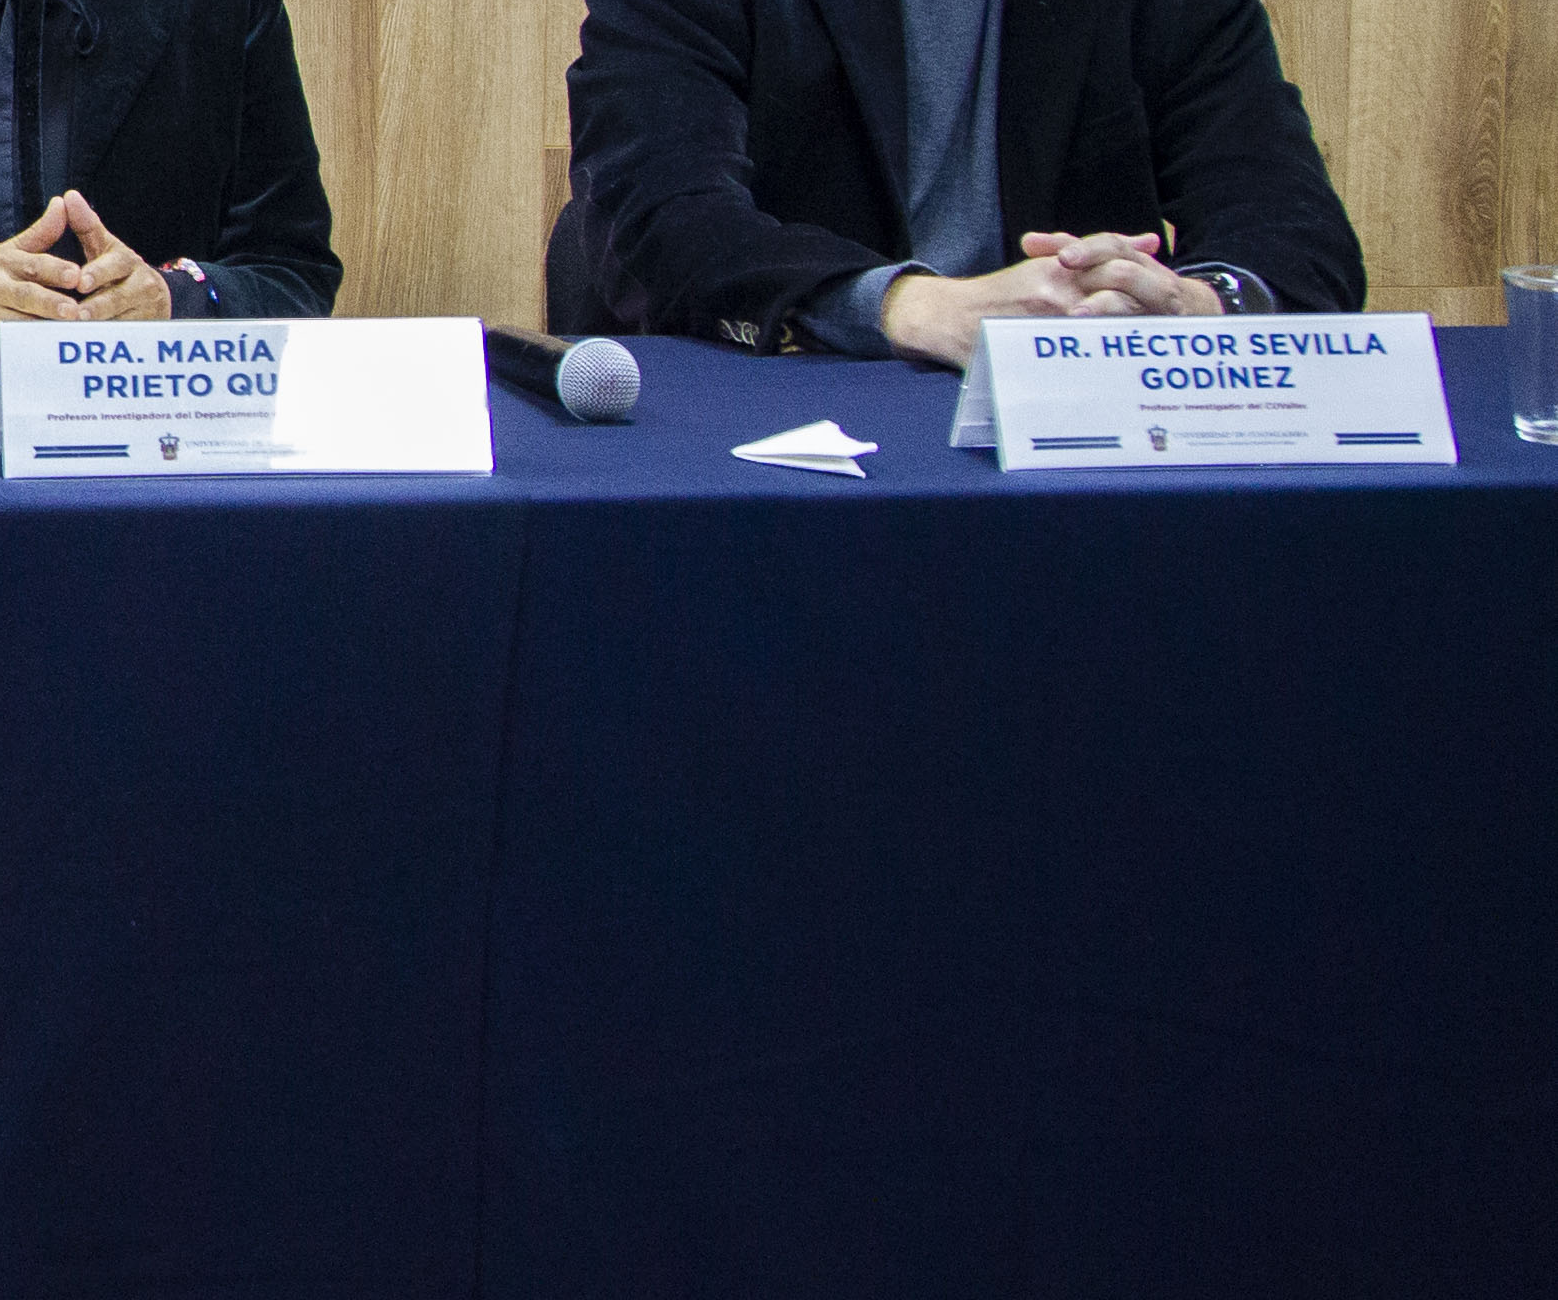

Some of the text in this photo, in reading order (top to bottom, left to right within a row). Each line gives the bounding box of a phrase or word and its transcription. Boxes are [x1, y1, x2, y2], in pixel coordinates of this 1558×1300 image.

[57, 333, 276, 364] DRA. MARÍA
[1033, 330, 1388, 359] DR. HÉCTOR SEVILLA
[83, 373, 214, 398] PRIETO
[1140, 361, 1296, 391] GODÍNEZ
[46, 413, 98, 422] Profesora
[175, 411, 192, 420] del
